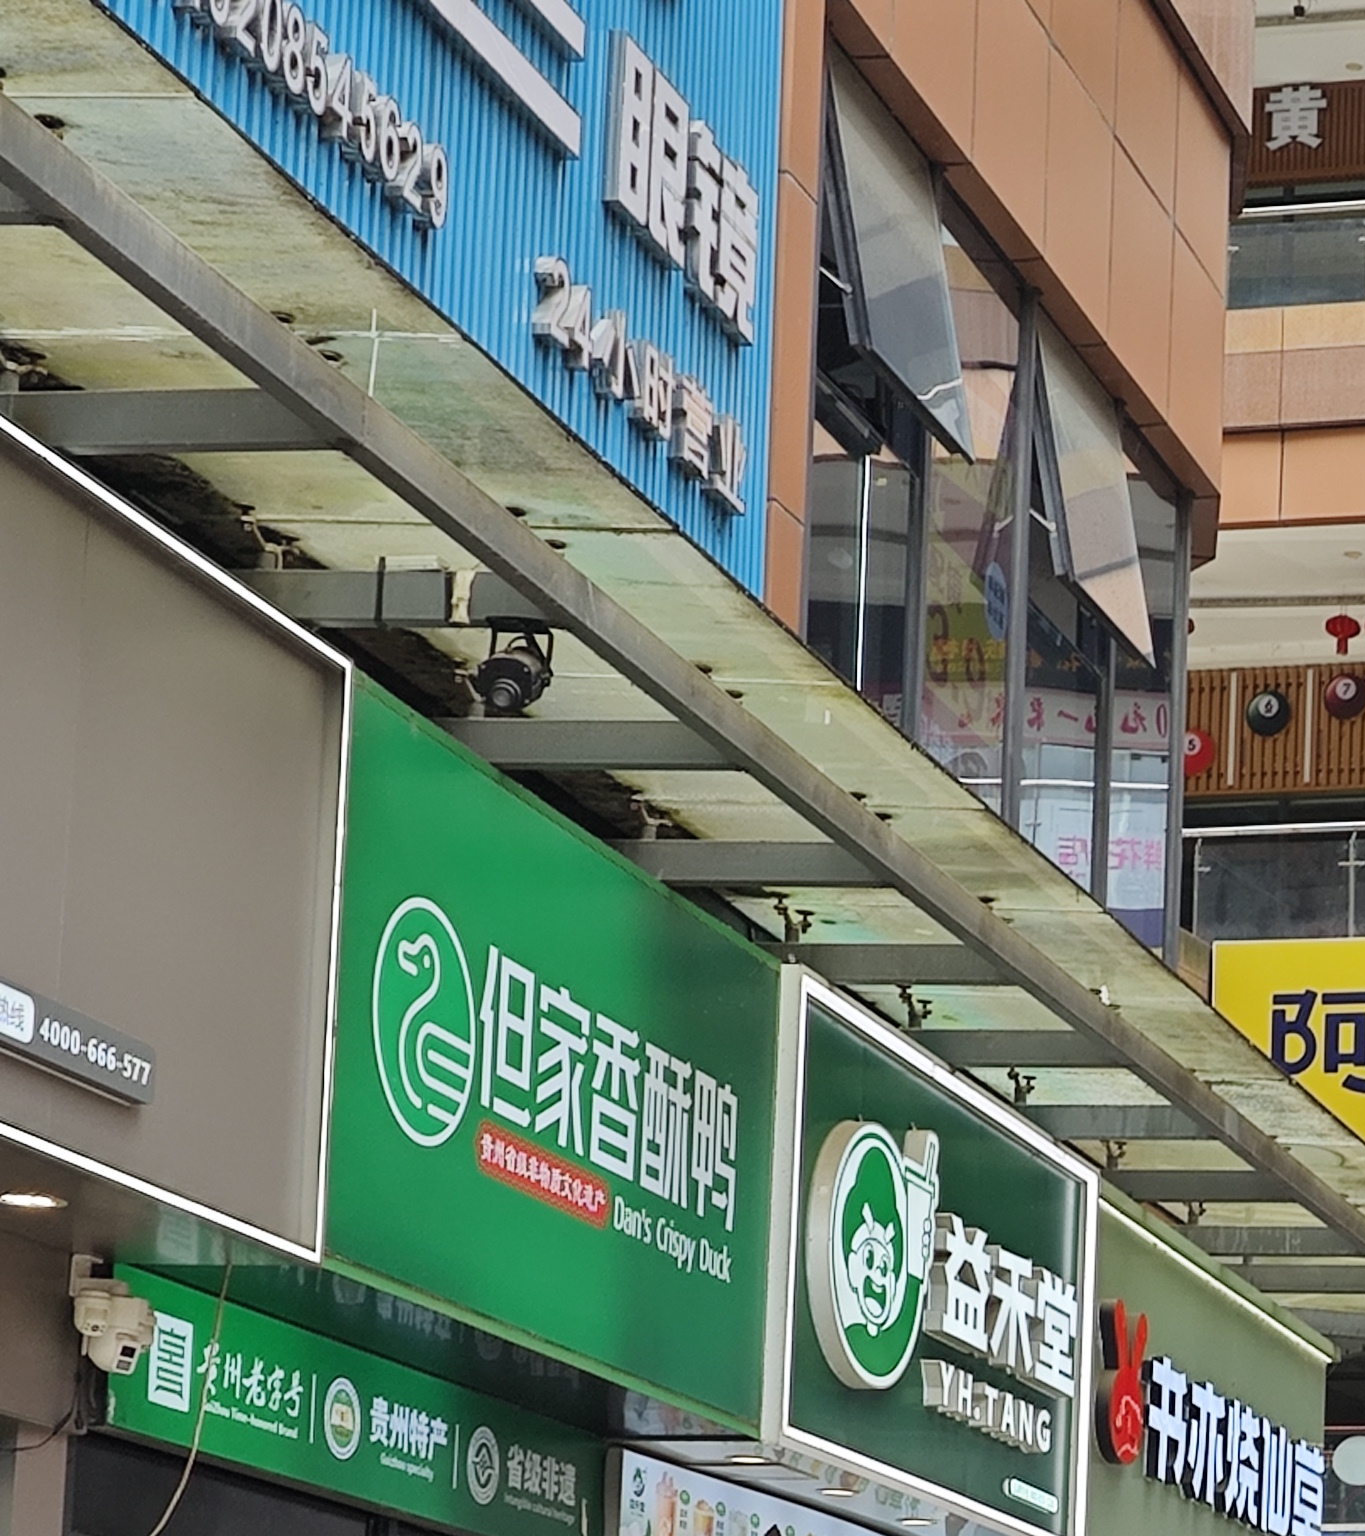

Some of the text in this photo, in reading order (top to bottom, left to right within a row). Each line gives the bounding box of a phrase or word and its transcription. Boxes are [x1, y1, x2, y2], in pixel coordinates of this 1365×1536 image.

[182, 0, 449, 230] 208545629
[610, 30, 758, 345] 眼镜
[534, 256, 746, 516] 24小时营业
[39, 1016, 152, 1087] 4000-666-577
[480, 945, 739, 1232] 但家香酥鸭
[613, 1195, 732, 1284] Dan's Crispy Duck
[943, 1212, 1077, 1398] 益禾堂
[369, 1396, 448, 1461] 贵州特产
[506, 1444, 577, 1508] 省级非遗
[938, 1357, 1052, 1453] YH.TANG
